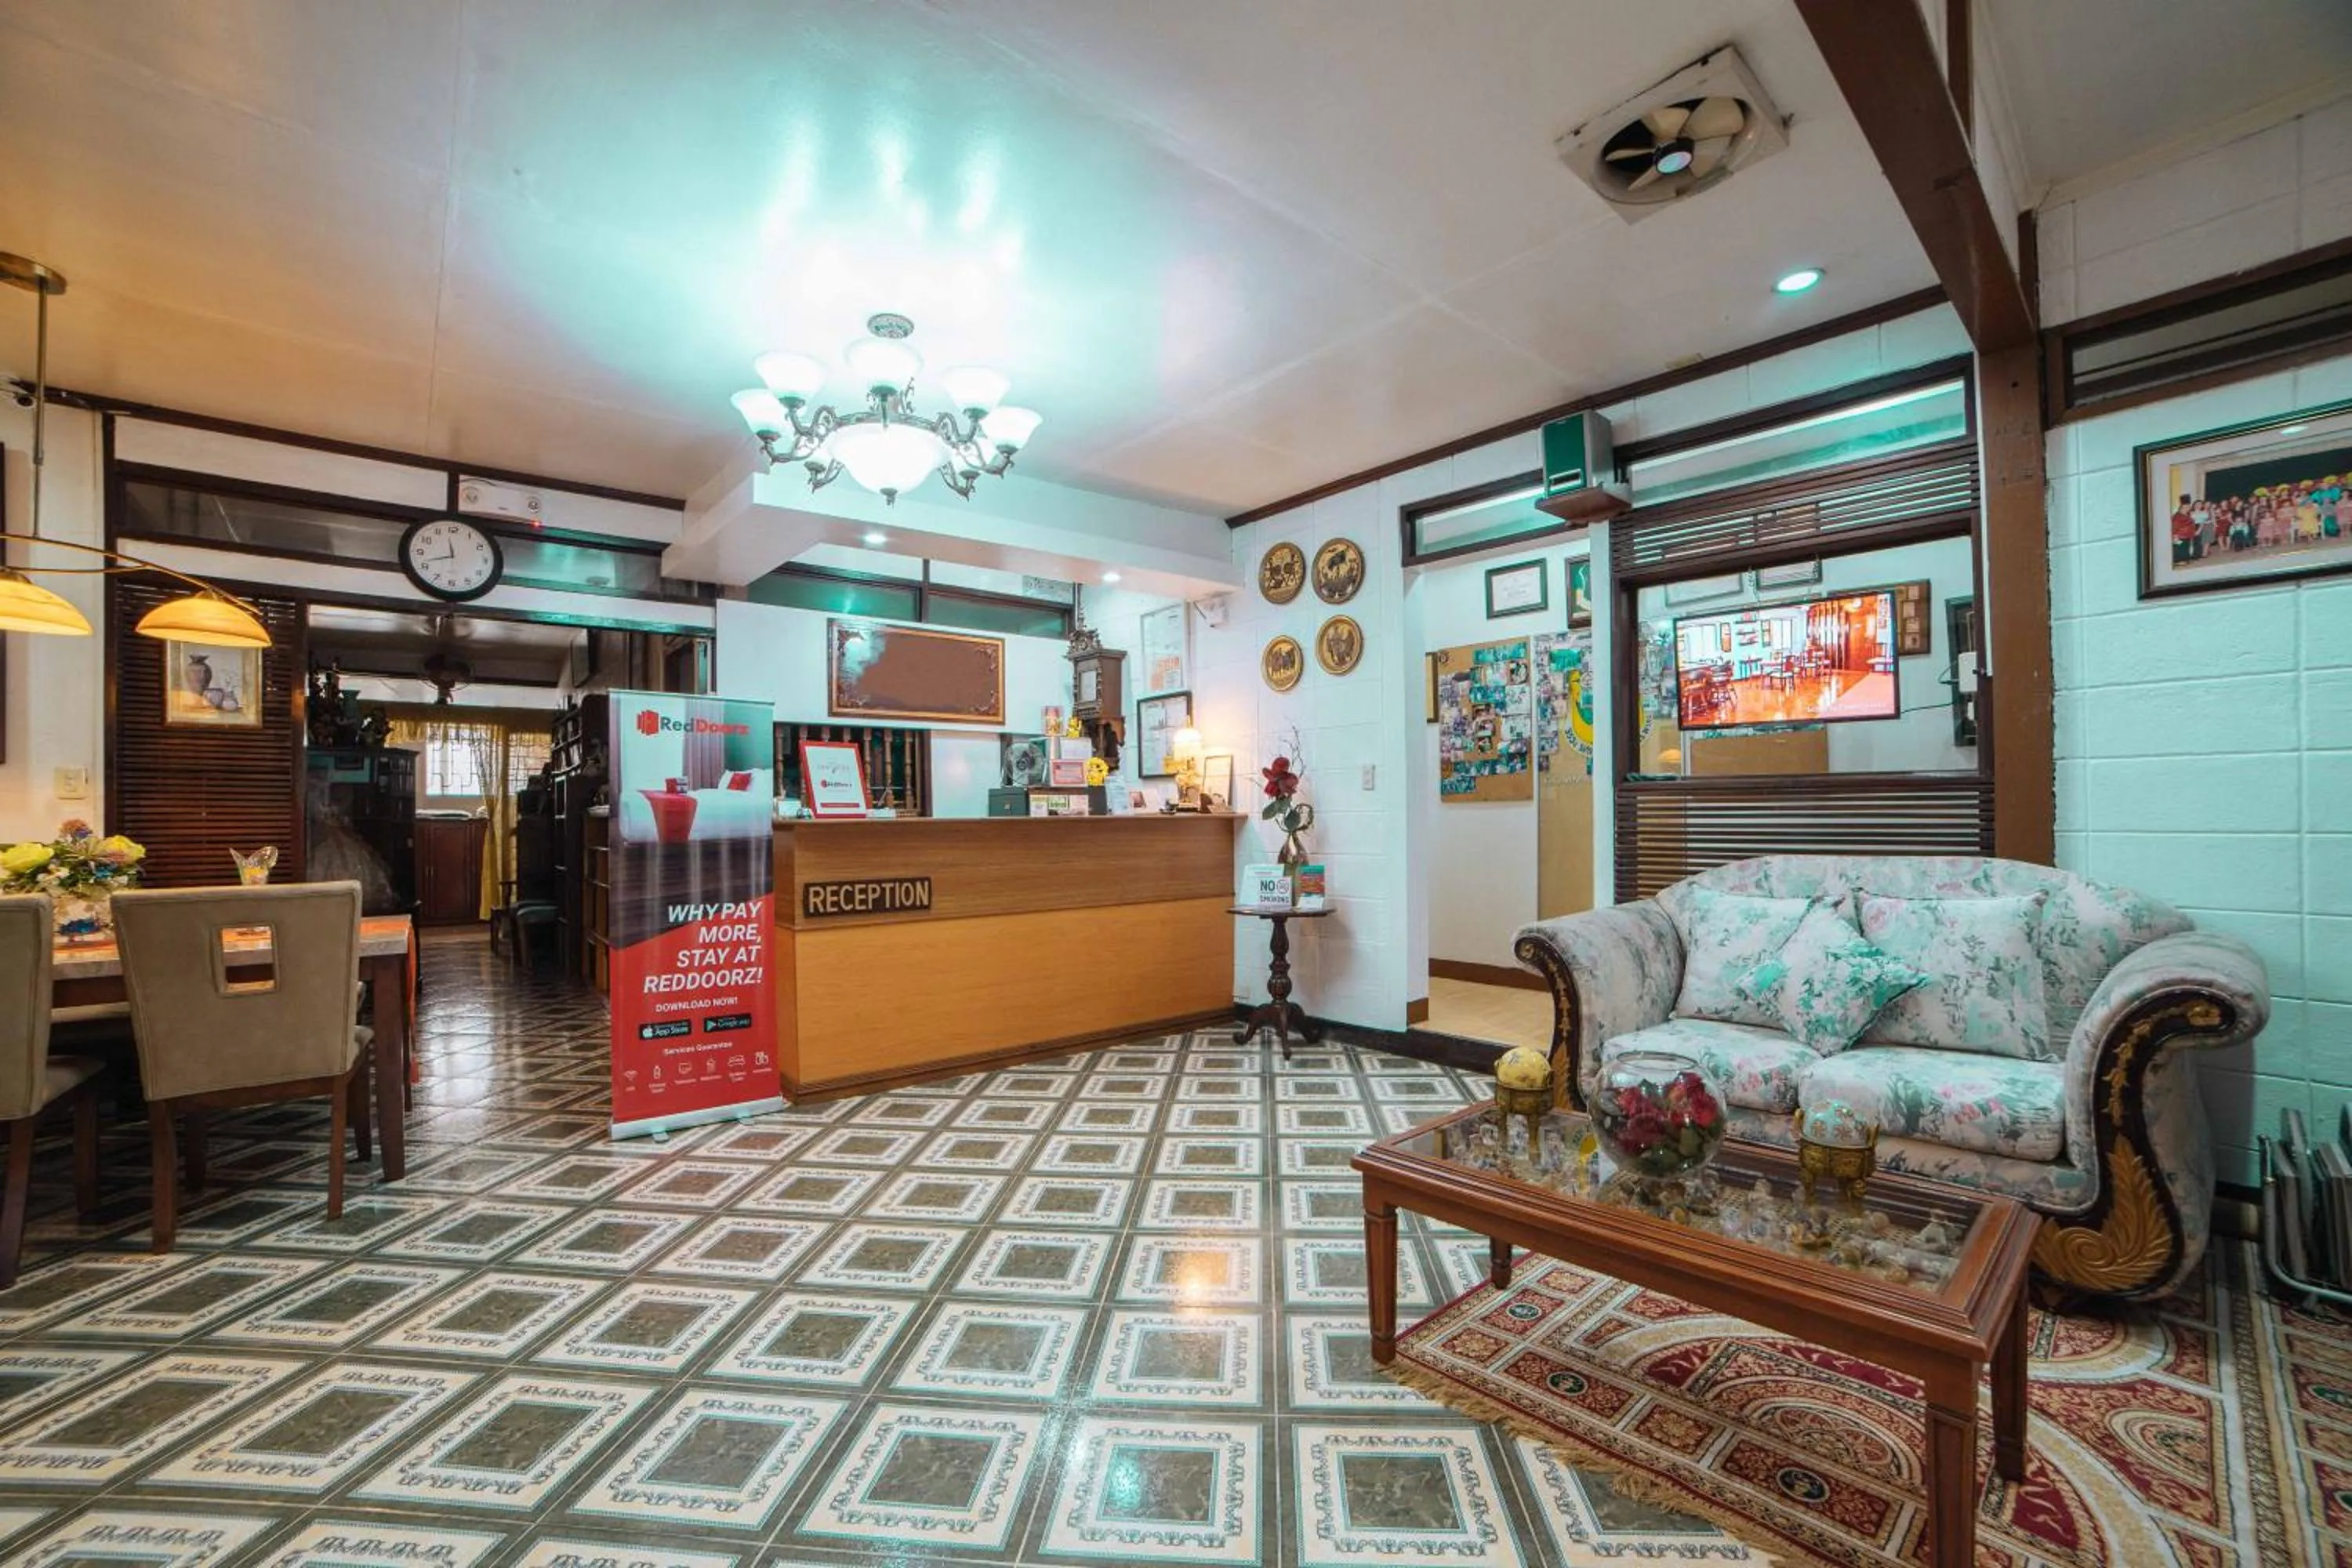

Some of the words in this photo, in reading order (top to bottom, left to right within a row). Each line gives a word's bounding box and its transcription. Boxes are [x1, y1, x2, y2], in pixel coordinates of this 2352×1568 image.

[1260, 880, 1276, 891] NO
[808, 880, 930, 913] RECEPTION
[669, 903, 718, 923] WHY
[720, 902, 762, 920] PAY
[699, 924, 762, 943] MORE,
[677, 948, 730, 967] STAY
[733, 945, 762, 964] AT
[643, 967, 763, 993] REDDOORZ!
[655, 999, 711, 1012] DOWNLOAD
[713, 996, 739, 1007] NOW!
